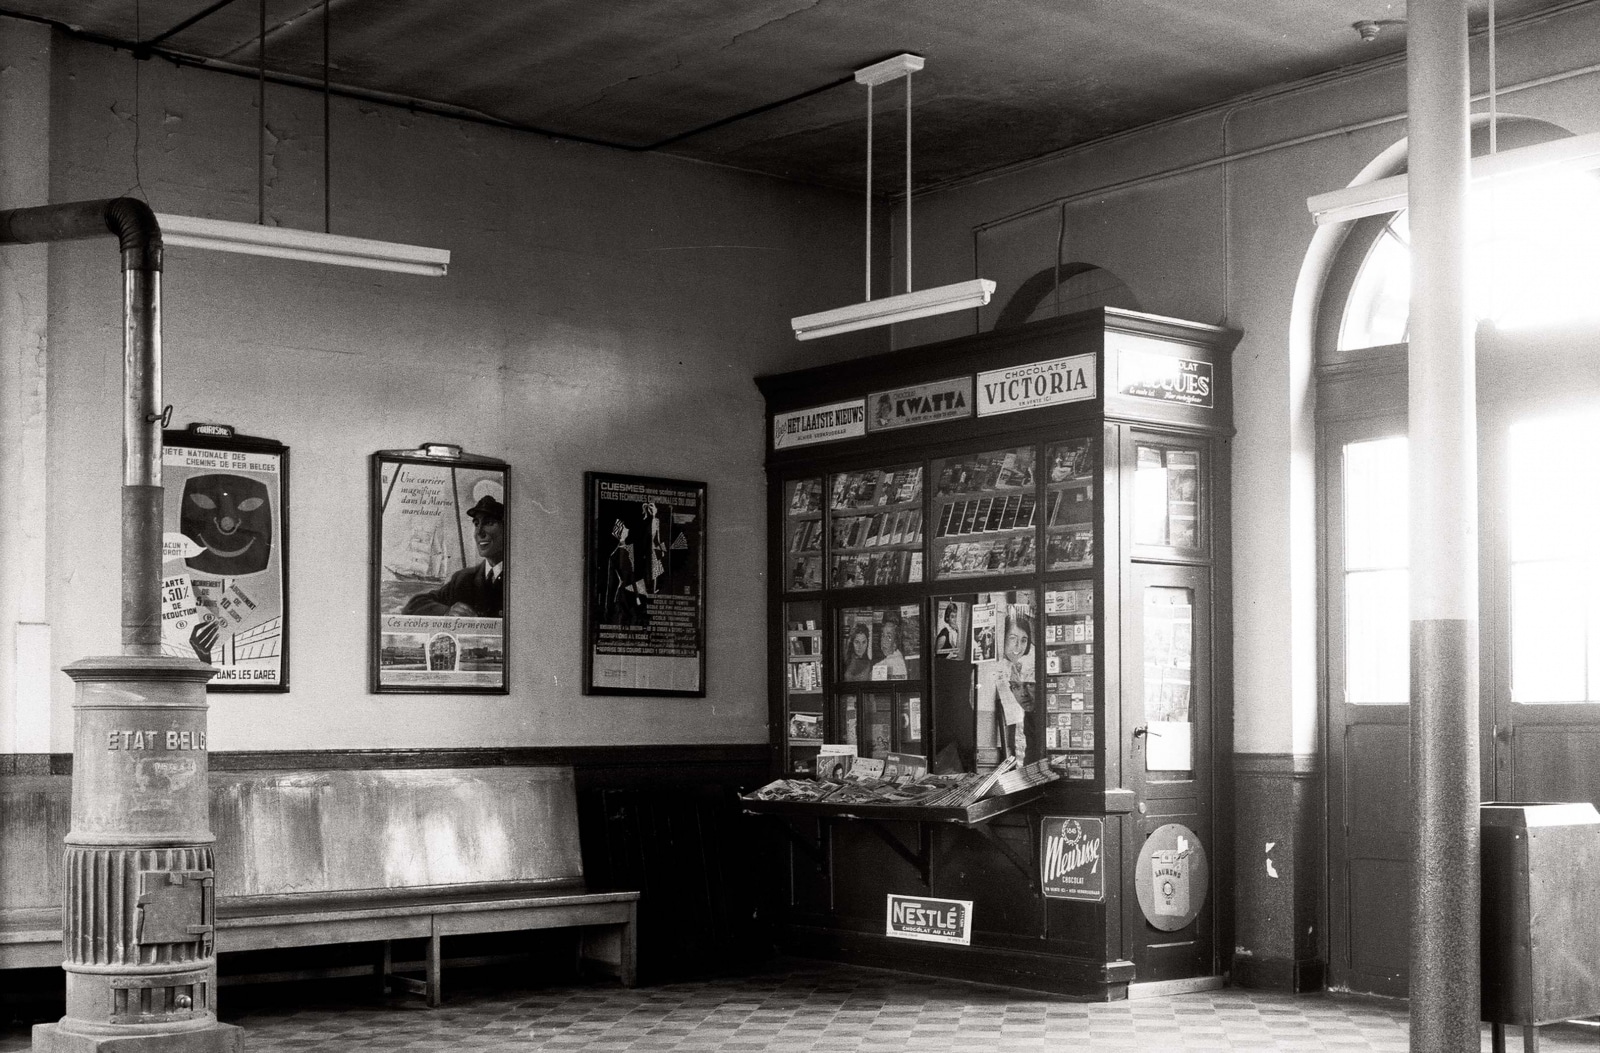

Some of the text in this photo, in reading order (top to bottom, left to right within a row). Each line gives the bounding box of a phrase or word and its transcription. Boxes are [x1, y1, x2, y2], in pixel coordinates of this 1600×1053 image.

[1004, 361, 1067, 380] CHOCOLATS
[984, 367, 1088, 405] VICTORIA
[896, 390, 966, 417] KWATTA
[787, 416, 801, 434] HET
[801, 410, 834, 432] LAATSTE
[835, 405, 864, 426] NIEUWS
[187, 449, 228, 460] NATIONALE
[186, 458, 216, 467] CHEMINS
[249, 463, 276, 471] BELGES
[400, 471, 415, 483] Une
[400, 486, 441, 498] magnifique
[600, 482, 645, 493] CUESMES
[400, 496, 454, 507] dans la Marine
[401, 507, 442, 516] marchande
[172, 602, 182, 610] DE
[220, 597, 232, 610] 10
[387, 616, 499, 632] Ces écoles vous formeront
[216, 669, 276, 680] DANS LES GARES
[1044, 834, 1100, 883] Meurisse
[1154, 868, 1182, 879] LAURENS
[1062, 876, 1084, 885] CHOCOLAT
[893, 901, 958, 930] NESTLÉ
